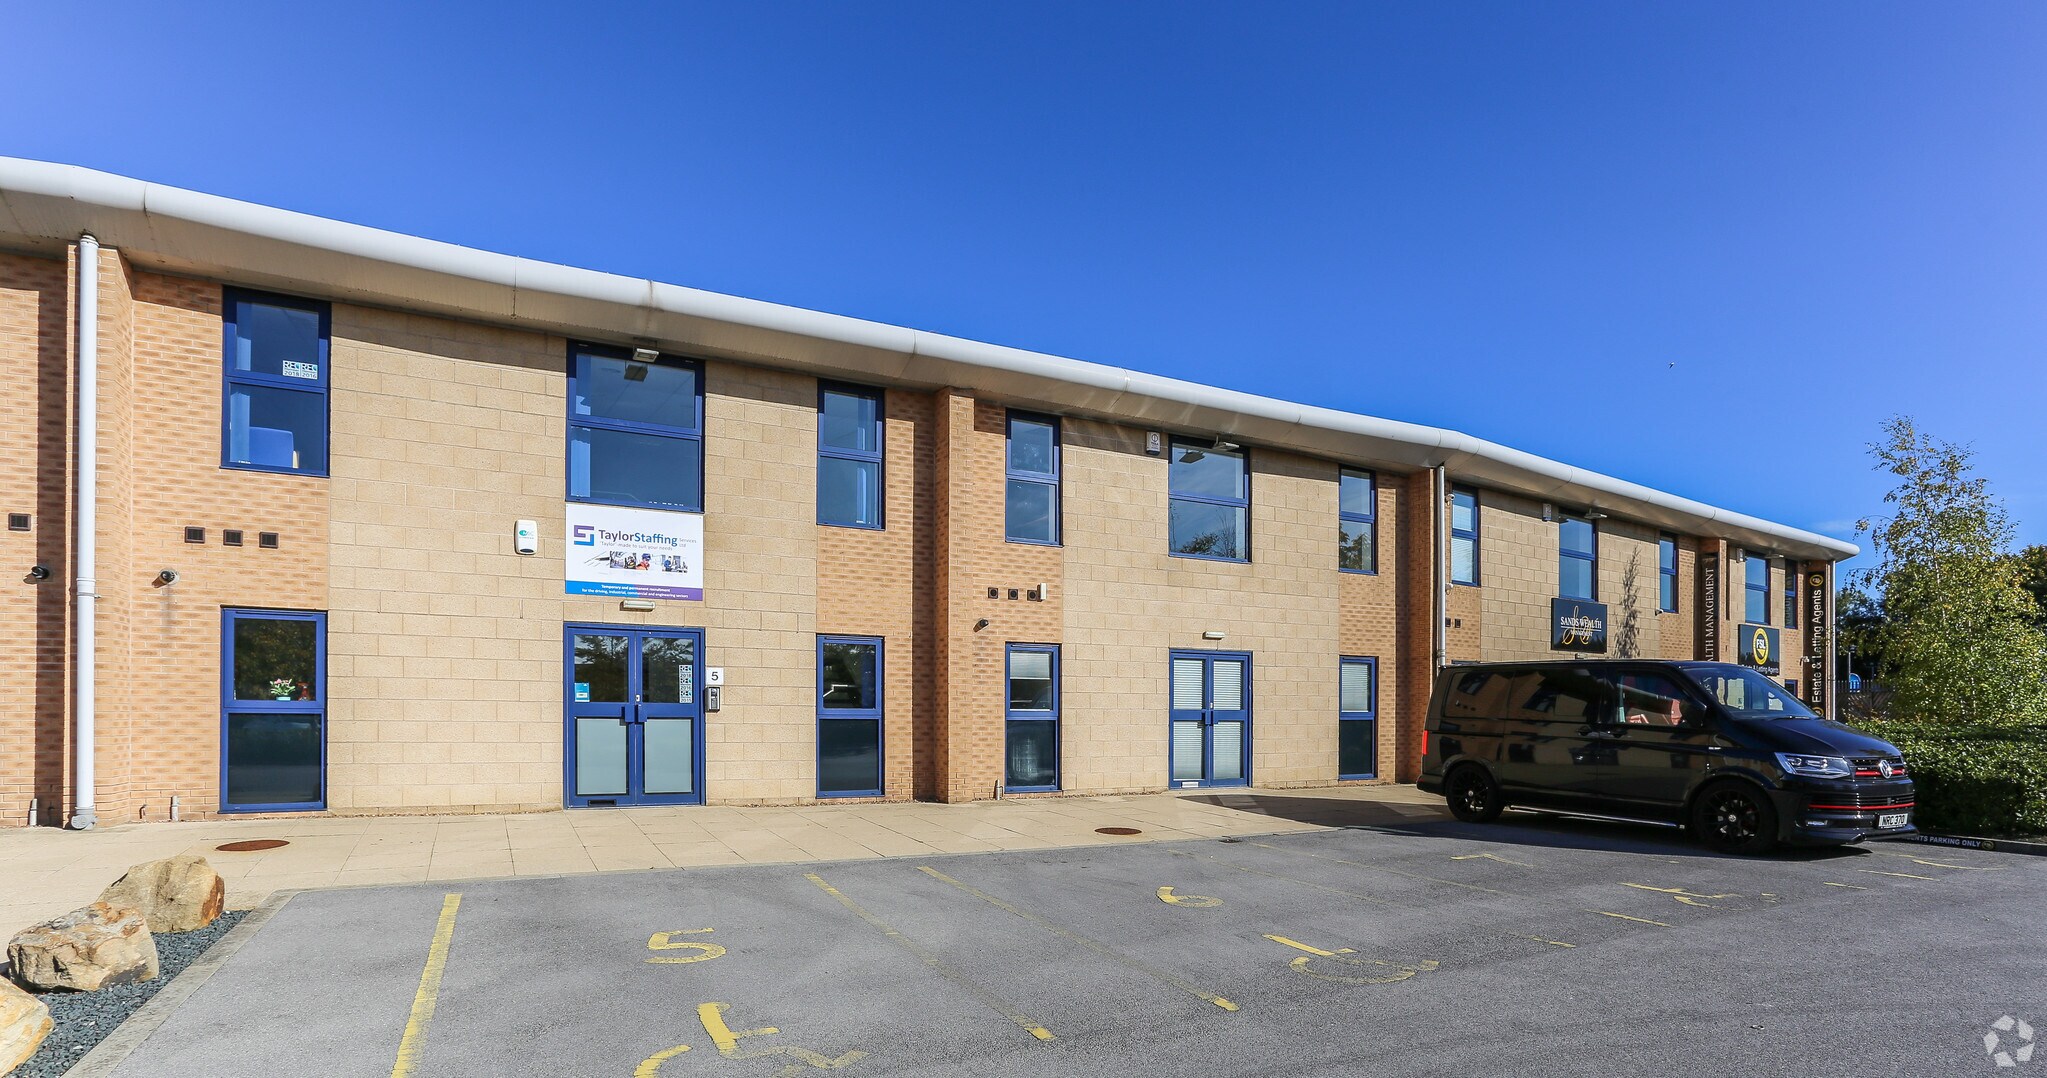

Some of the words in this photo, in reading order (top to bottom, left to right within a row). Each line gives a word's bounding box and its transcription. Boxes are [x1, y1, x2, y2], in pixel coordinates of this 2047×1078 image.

[598, 529, 678, 547] TaylorStaffing
[1705, 567, 1714, 637] MANAGEMENT
[1811, 589, 1824, 624] Agents
[1705, 640, 1714, 662] ALTH
[711, 671, 719, 681] 5
[1811, 661, 1822, 669] &
[1811, 672, 1822, 703] Estate
[1929, 836, 1960, 846] PARKING
[1961, 840, 1981, 848] ONLY
[1156, 886, 1224, 908] 6
[643, 927, 727, 964] 5
